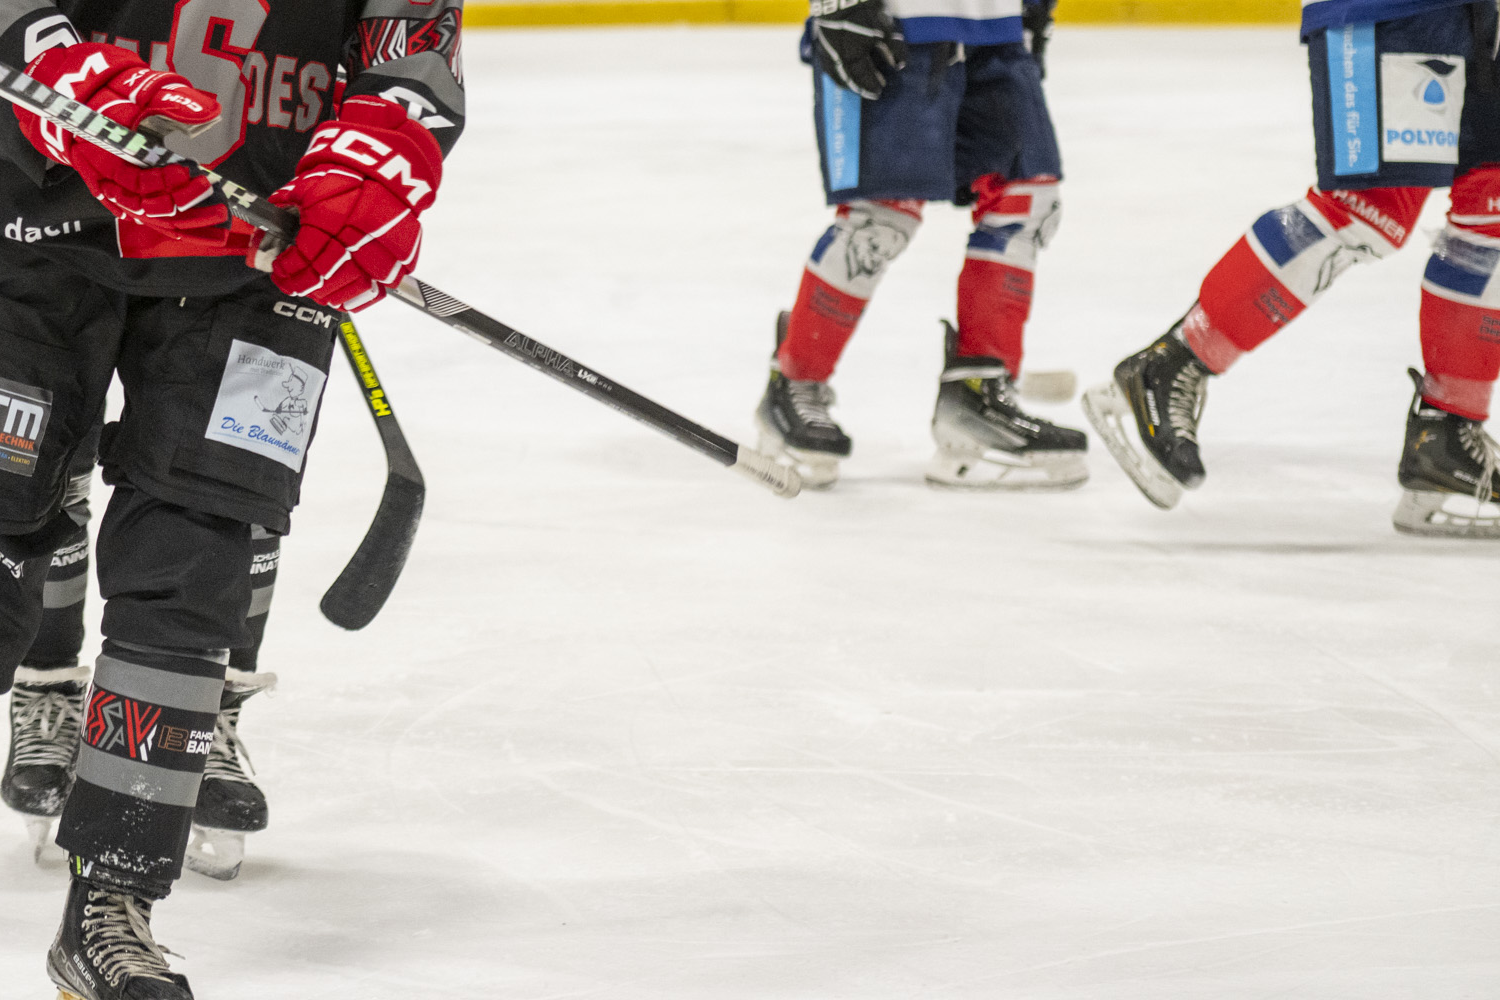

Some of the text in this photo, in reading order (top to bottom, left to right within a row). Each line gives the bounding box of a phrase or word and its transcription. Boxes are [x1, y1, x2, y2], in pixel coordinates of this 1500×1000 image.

[305, 127, 433, 207] CCM
[272, 300, 333, 329] CCM
[236, 354, 286, 371] Handwerk
[503, 330, 575, 378] ALPHA
[220, 416, 243, 435] Die
